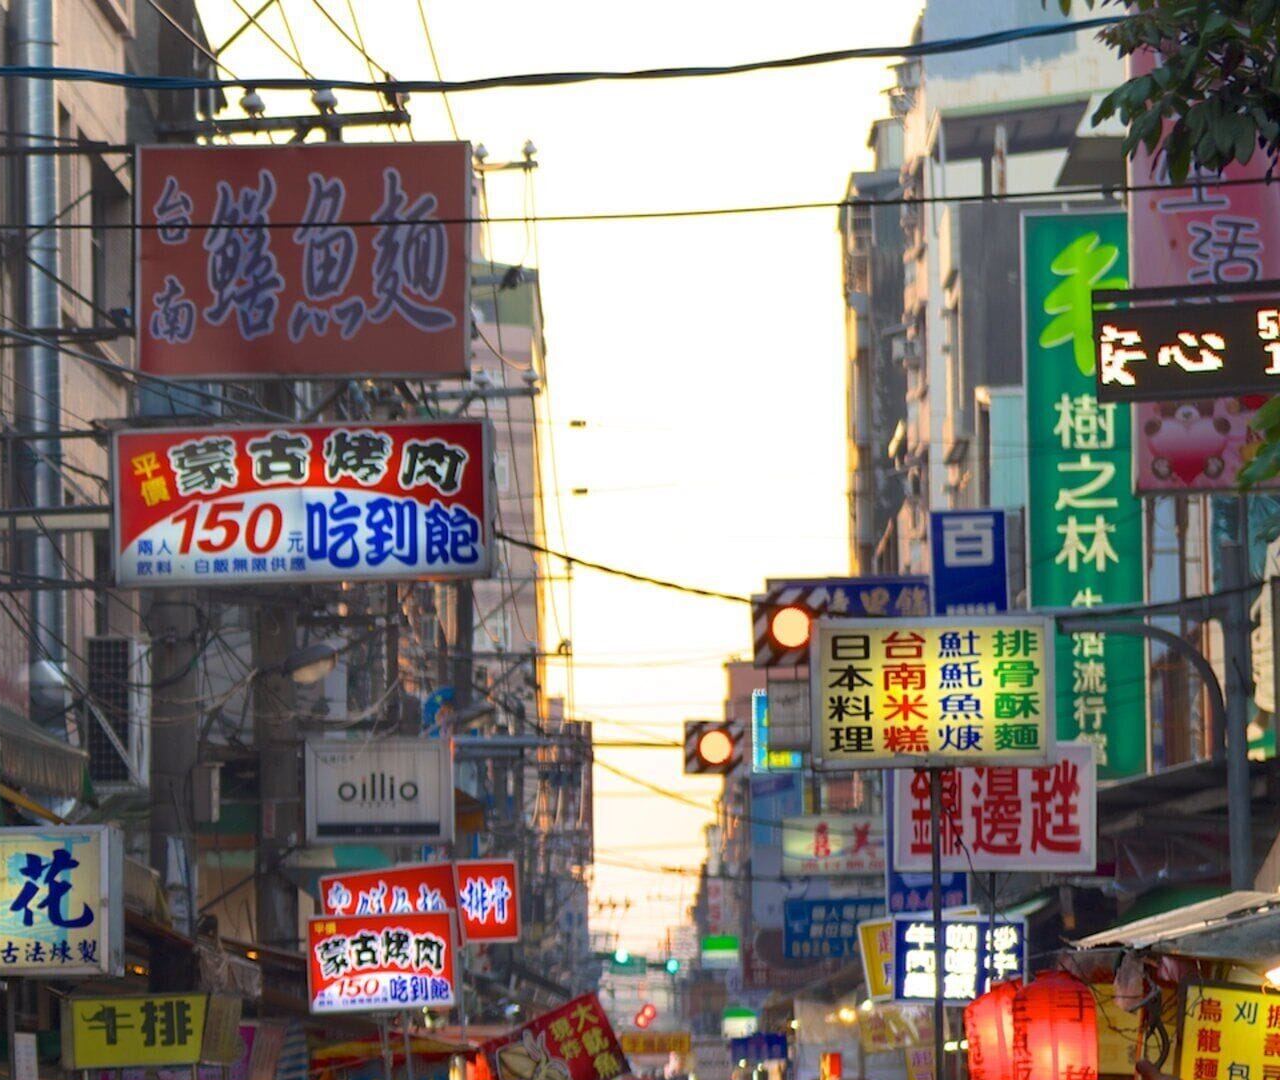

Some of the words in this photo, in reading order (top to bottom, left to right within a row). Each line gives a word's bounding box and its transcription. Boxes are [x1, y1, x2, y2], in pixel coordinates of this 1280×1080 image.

[150, 177, 196, 344] 台南
[130, 451, 172, 507] 平價
[167, 429, 469, 496] 蒙古烤肉
[1052, 394, 1119, 573] 樹之林
[169, 500, 284, 555] 150
[306, 492, 479, 568] 吃到飽
[943, 517, 995, 568] 百
[828, 635, 874, 752] 日本料理
[881, 631, 930, 753] 台南米糕
[992, 630, 1040, 751] 排骨酥麵
[338, 773, 418, 801] oillio
[317, 930, 443, 976] 蒙古烤肉
[81, 1001, 192, 1046] 牛排
